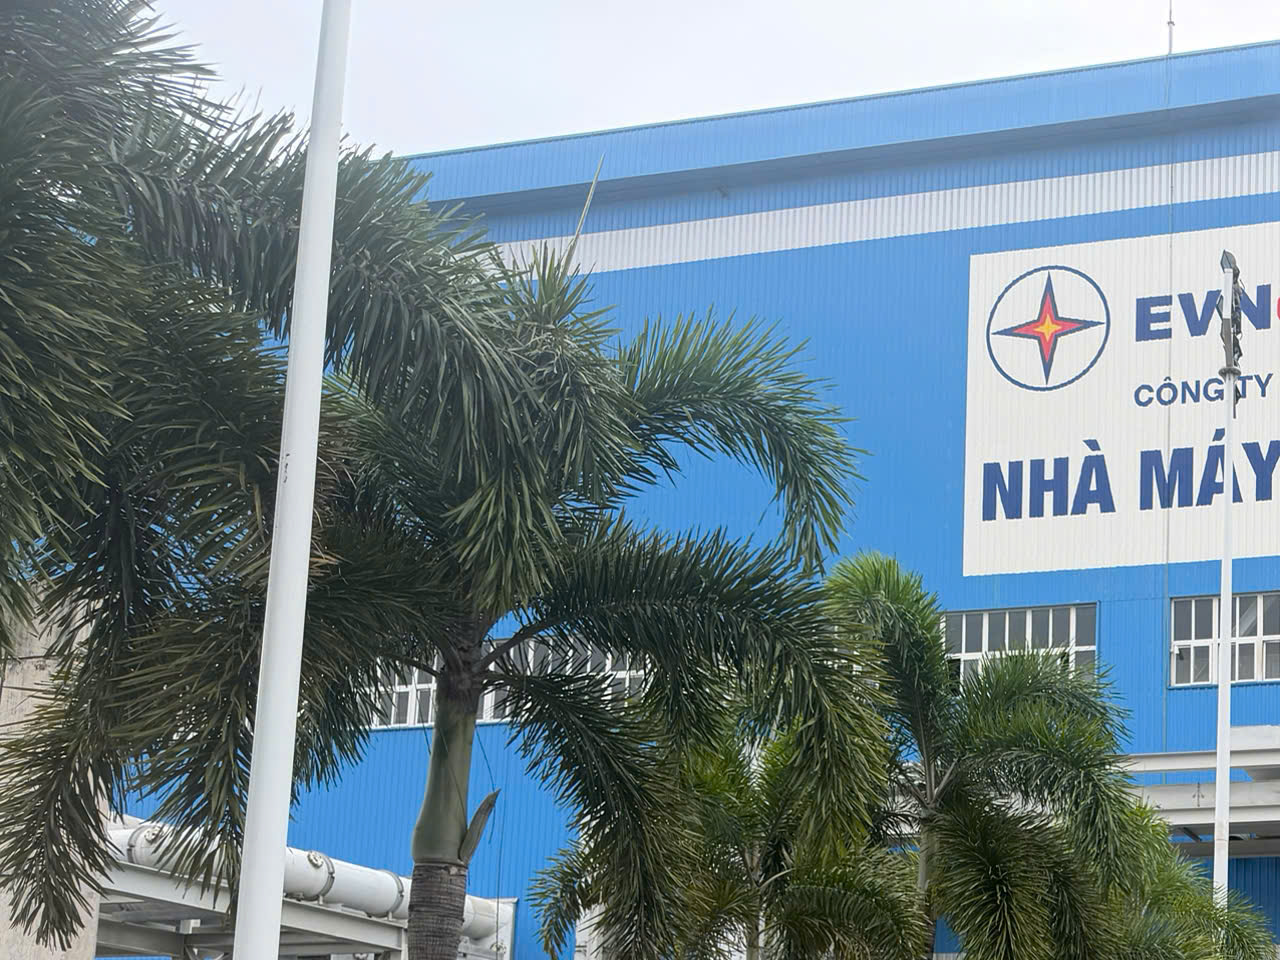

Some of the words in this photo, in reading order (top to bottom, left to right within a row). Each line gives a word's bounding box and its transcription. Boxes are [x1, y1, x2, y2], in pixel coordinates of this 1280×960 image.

[1133, 375, 1225, 407] CÔNG
[1237, 372, 1274, 399] TY
[981, 438, 1116, 521] NHÀ
